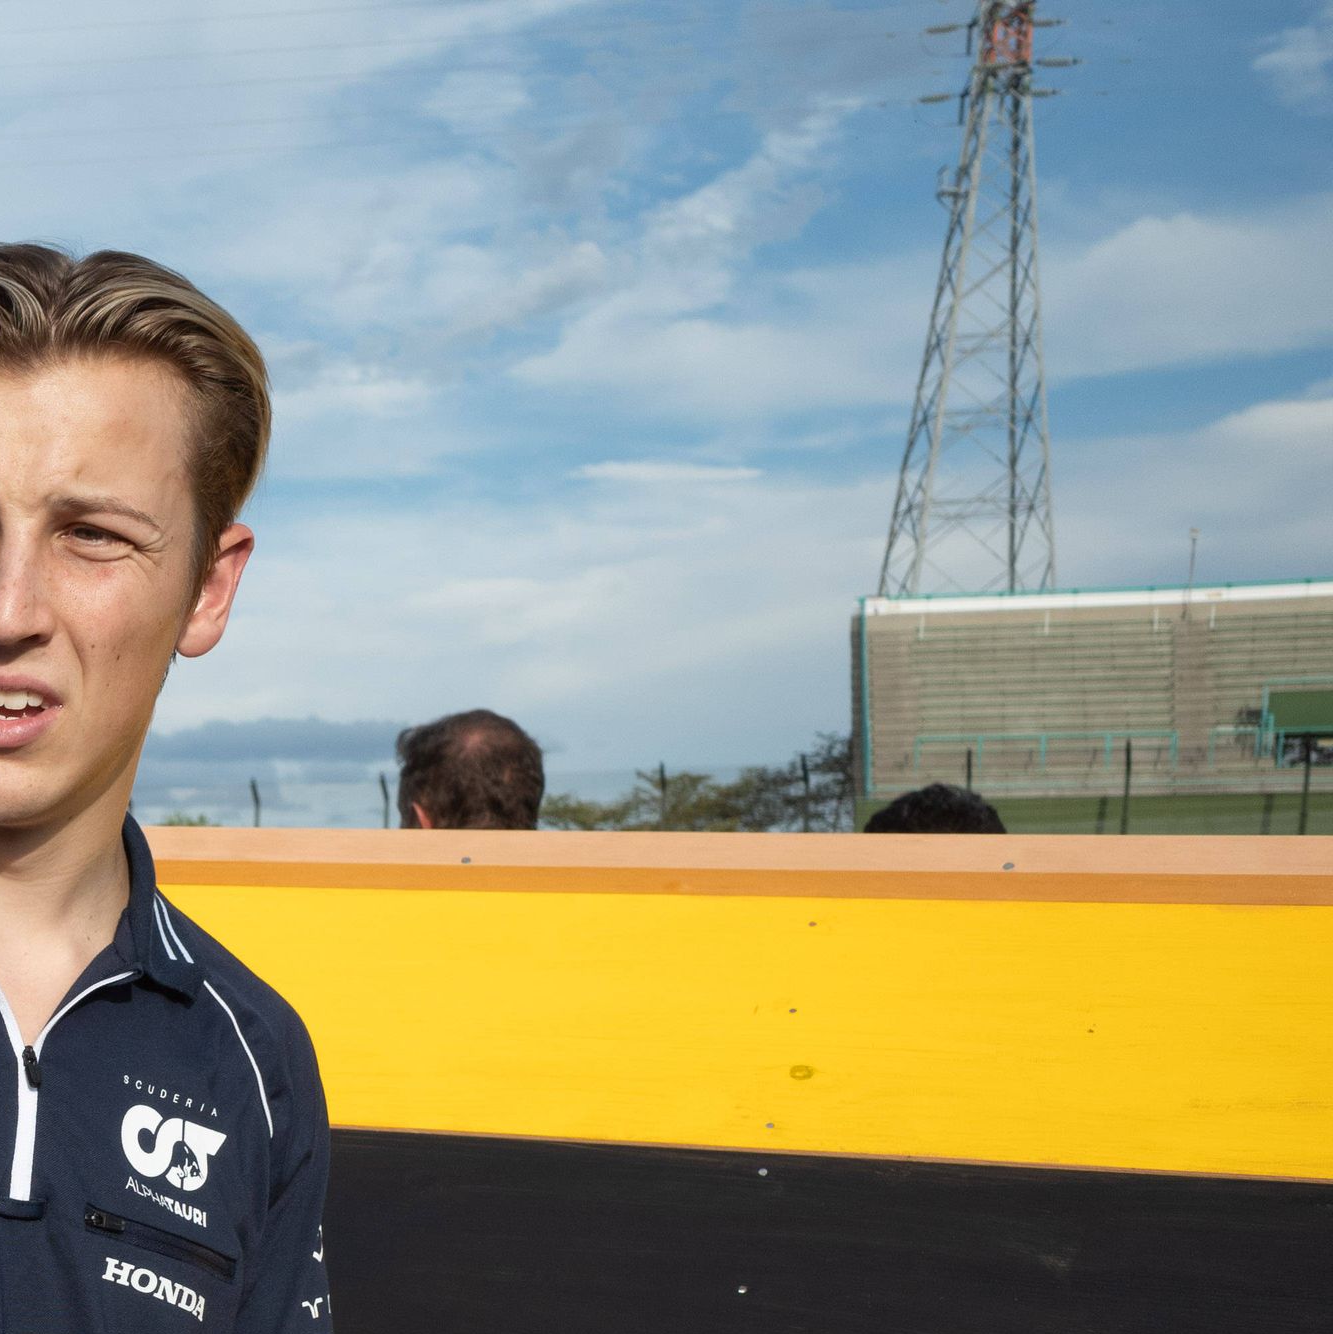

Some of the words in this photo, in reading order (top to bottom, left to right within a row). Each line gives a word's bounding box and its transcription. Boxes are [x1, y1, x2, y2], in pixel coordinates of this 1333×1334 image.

[123, 1074, 218, 1117] SCUDERIA
[125, 1176, 207, 1228] ALPHATAURI
[102, 1256, 206, 1322] HONDA
